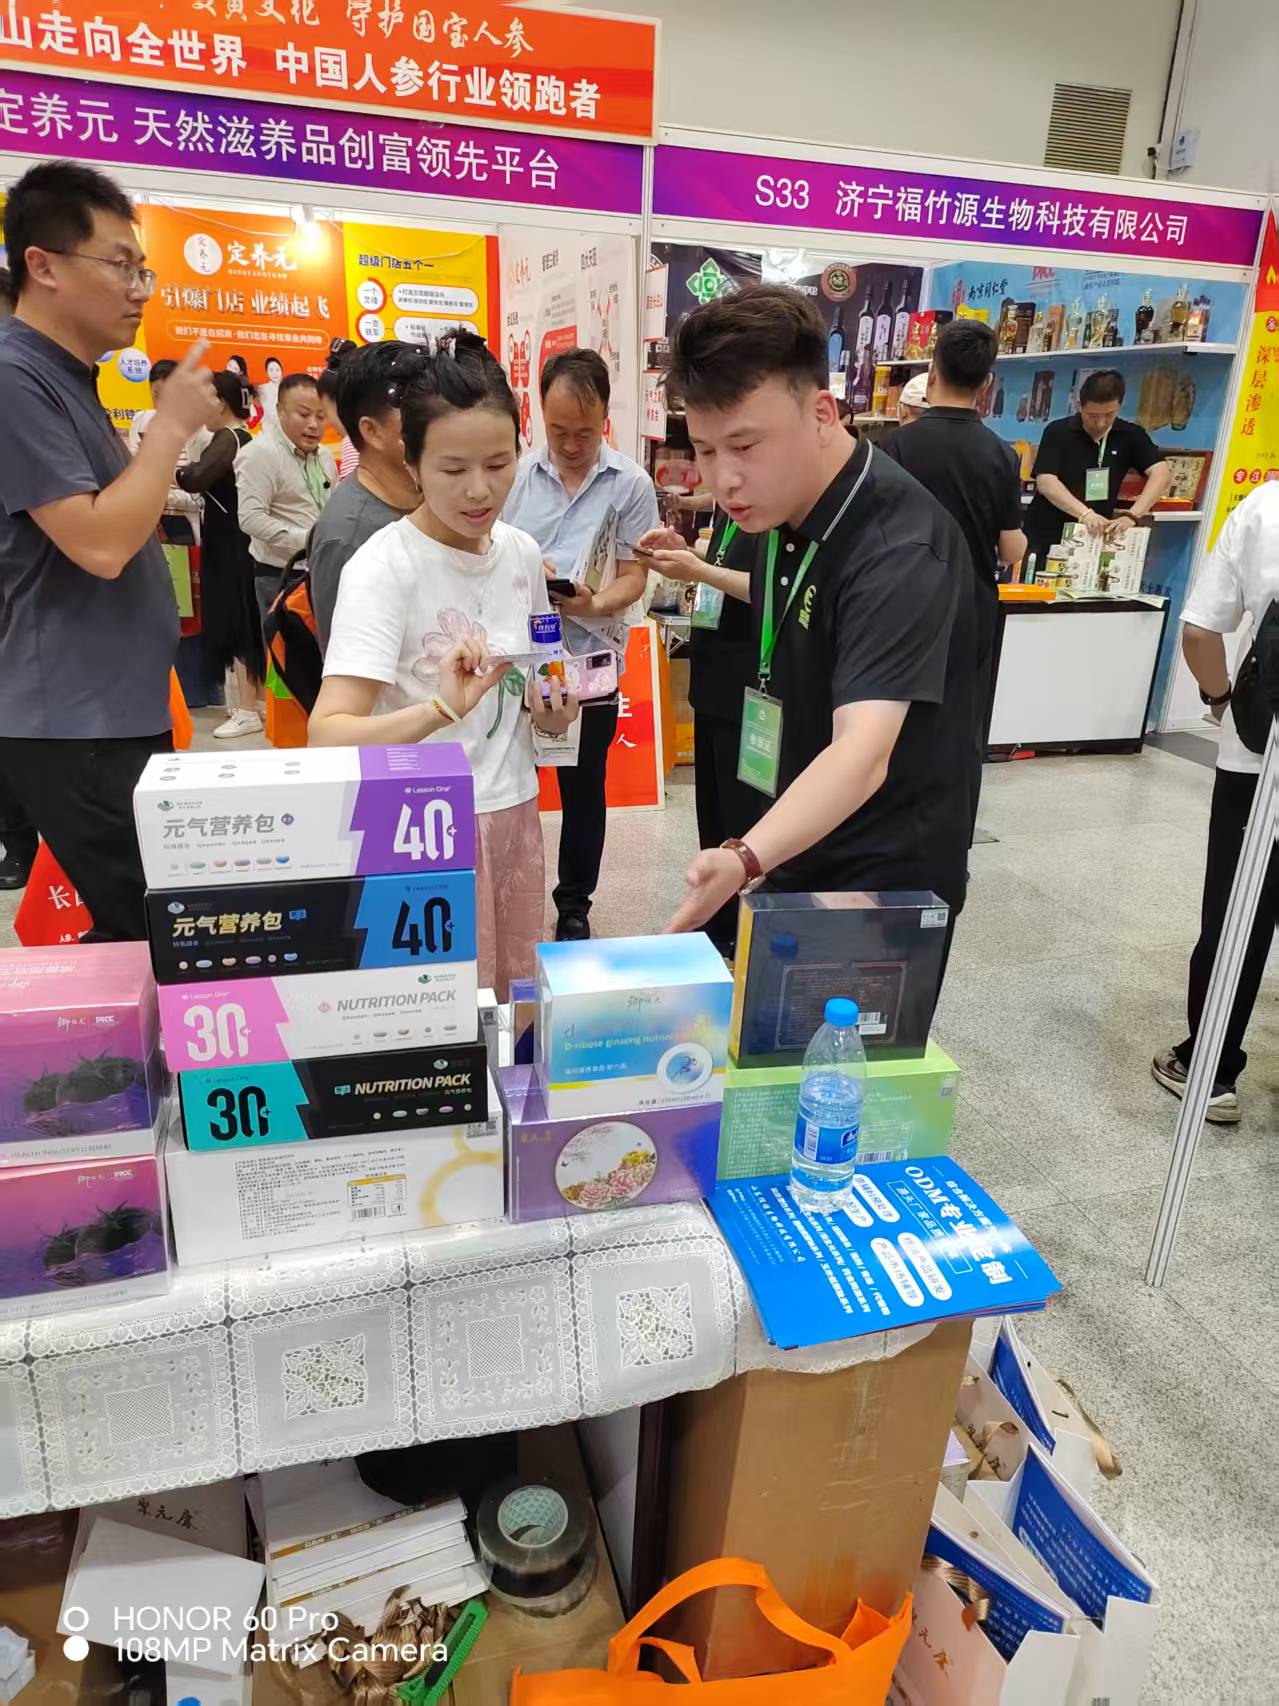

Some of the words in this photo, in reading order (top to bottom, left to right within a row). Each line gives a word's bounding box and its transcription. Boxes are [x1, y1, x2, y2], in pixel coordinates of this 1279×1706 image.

[0, 0, 248, 77] 山走向全世界
[275, 41, 601, 120] 中国人参行业领跑者
[0, 87, 119, 144] 定养元
[133, 106, 560, 190] 天然滋养品创富领先平台
[754, 174, 811, 211] S33
[835, 179, 1190, 247] 济宁福竹源生物科技有限公司
[226, 239, 298, 271] 定养元
[358, 254, 435, 271] 超级门店五个一
[160, 284, 244, 314] 引爆门店
[251, 288, 331, 320] 业绩起飞
[163, 813, 275, 839] 元气营养包
[172, 910, 283, 937] 元气营养包
[336, 993, 418, 1012] NUTRITION
[420, 989, 457, 1005] PACK
[354, 1076, 434, 1096] NUTRITION
[434, 1073, 472, 1088] PACK
